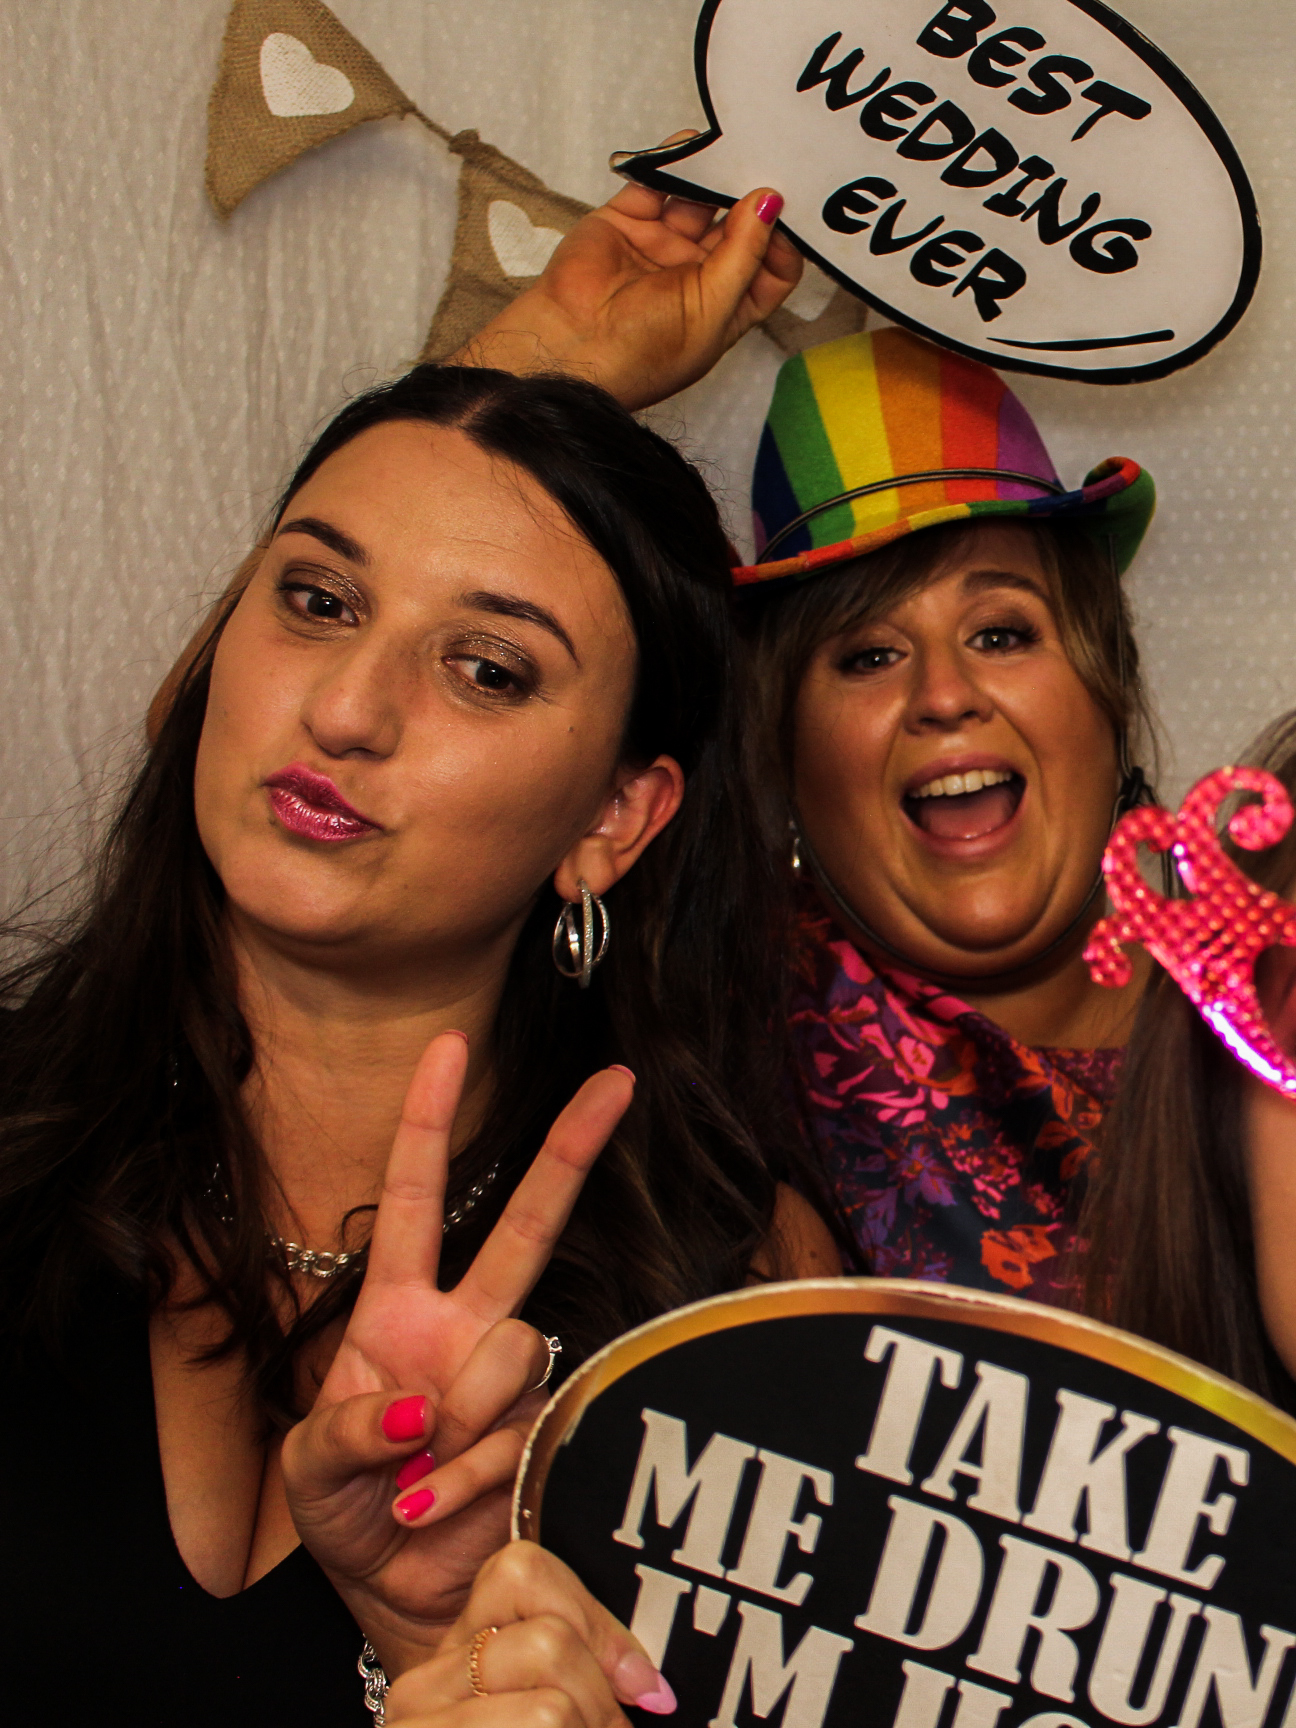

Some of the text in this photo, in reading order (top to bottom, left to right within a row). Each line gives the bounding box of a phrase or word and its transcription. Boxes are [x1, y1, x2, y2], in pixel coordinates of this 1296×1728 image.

[796, 31, 1152, 275] WEDDING
[916, 0, 1152, 142] BEST
[821, 176, 1027, 323] EVER
[612, 1407, 834, 1607] ME
[854, 1324, 1250, 1591] TAKE
[629, 1562, 855, 1728] I'M
